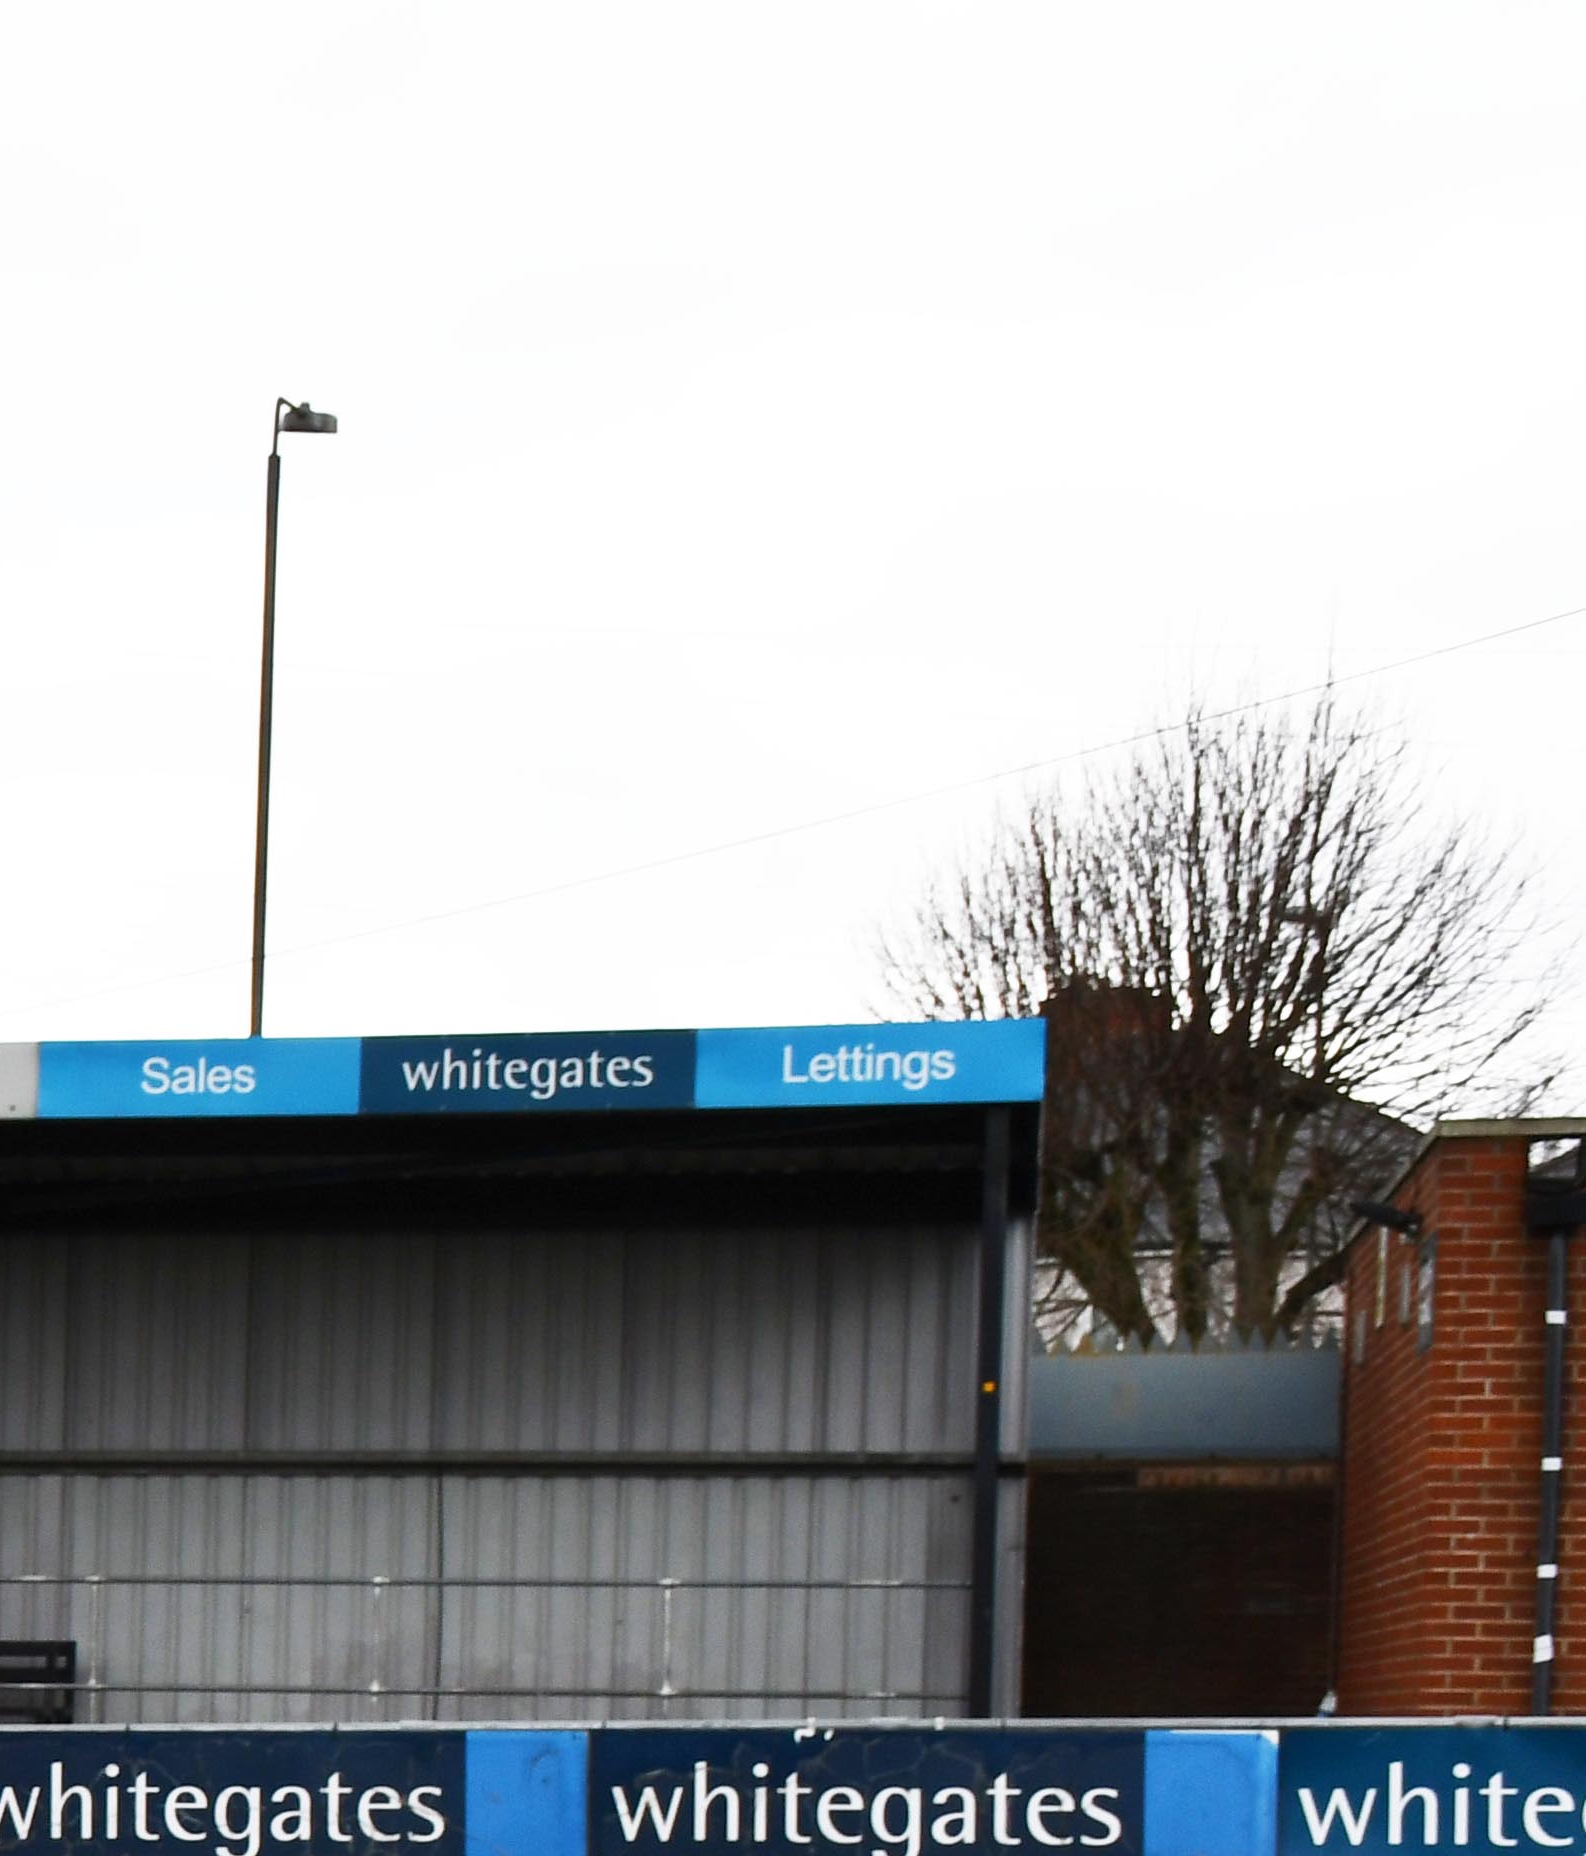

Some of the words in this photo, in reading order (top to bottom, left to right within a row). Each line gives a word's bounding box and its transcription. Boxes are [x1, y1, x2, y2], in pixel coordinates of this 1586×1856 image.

[140, 1057, 257, 1096] Sales
[401, 1048, 654, 1101] whitegates
[782, 1044, 957, 1092] Lettings
